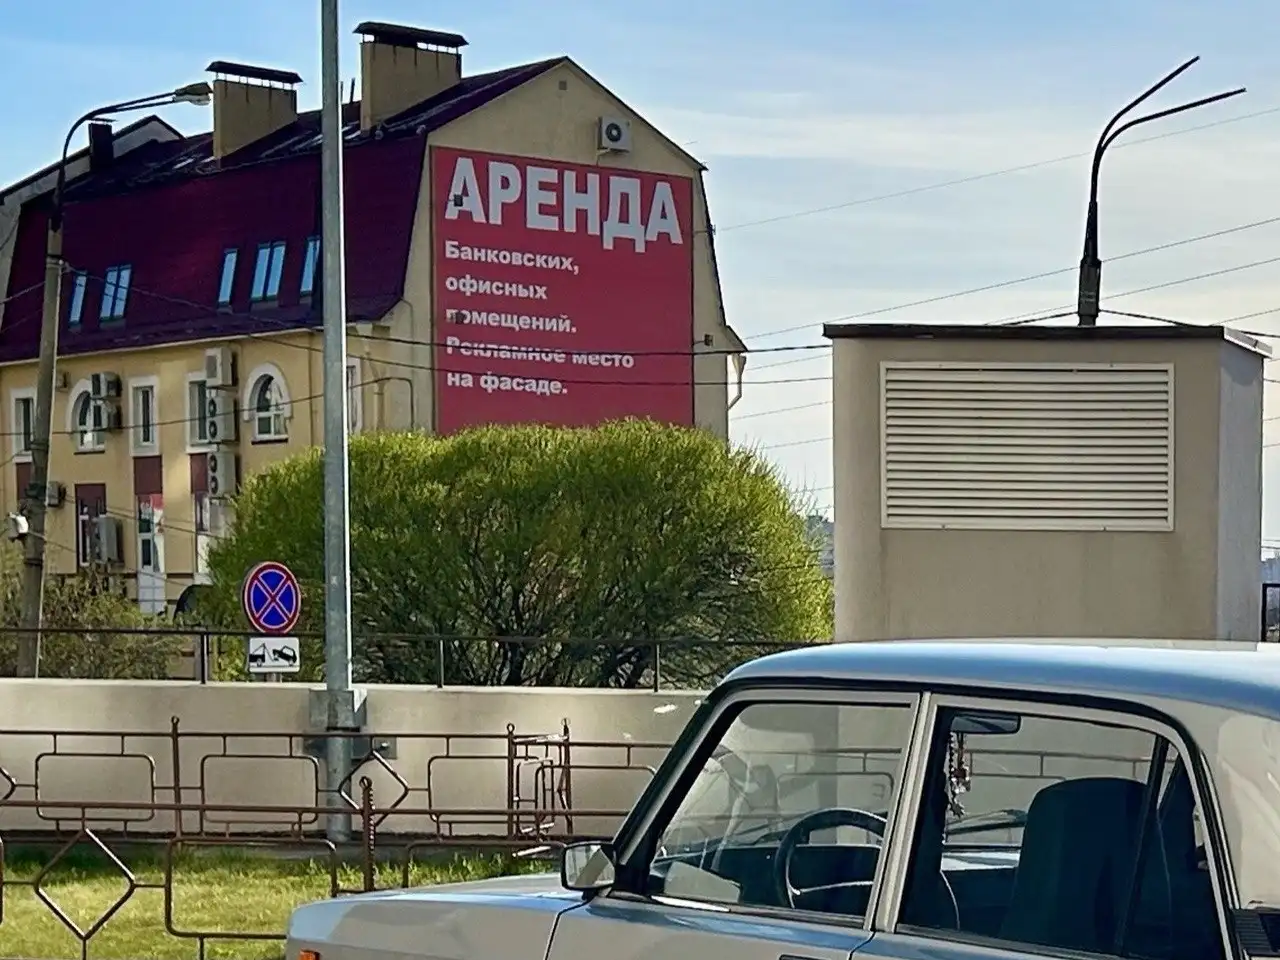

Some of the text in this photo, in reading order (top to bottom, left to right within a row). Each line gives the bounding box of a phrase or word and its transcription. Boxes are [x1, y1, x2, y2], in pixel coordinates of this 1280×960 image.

[445, 157, 683, 253] АРЕНДА
[445, 240, 579, 275] Банковских,
[445, 274, 548, 299] офисных
[572, 353, 634, 368] место
[447, 371, 568, 396] на фасаде.
